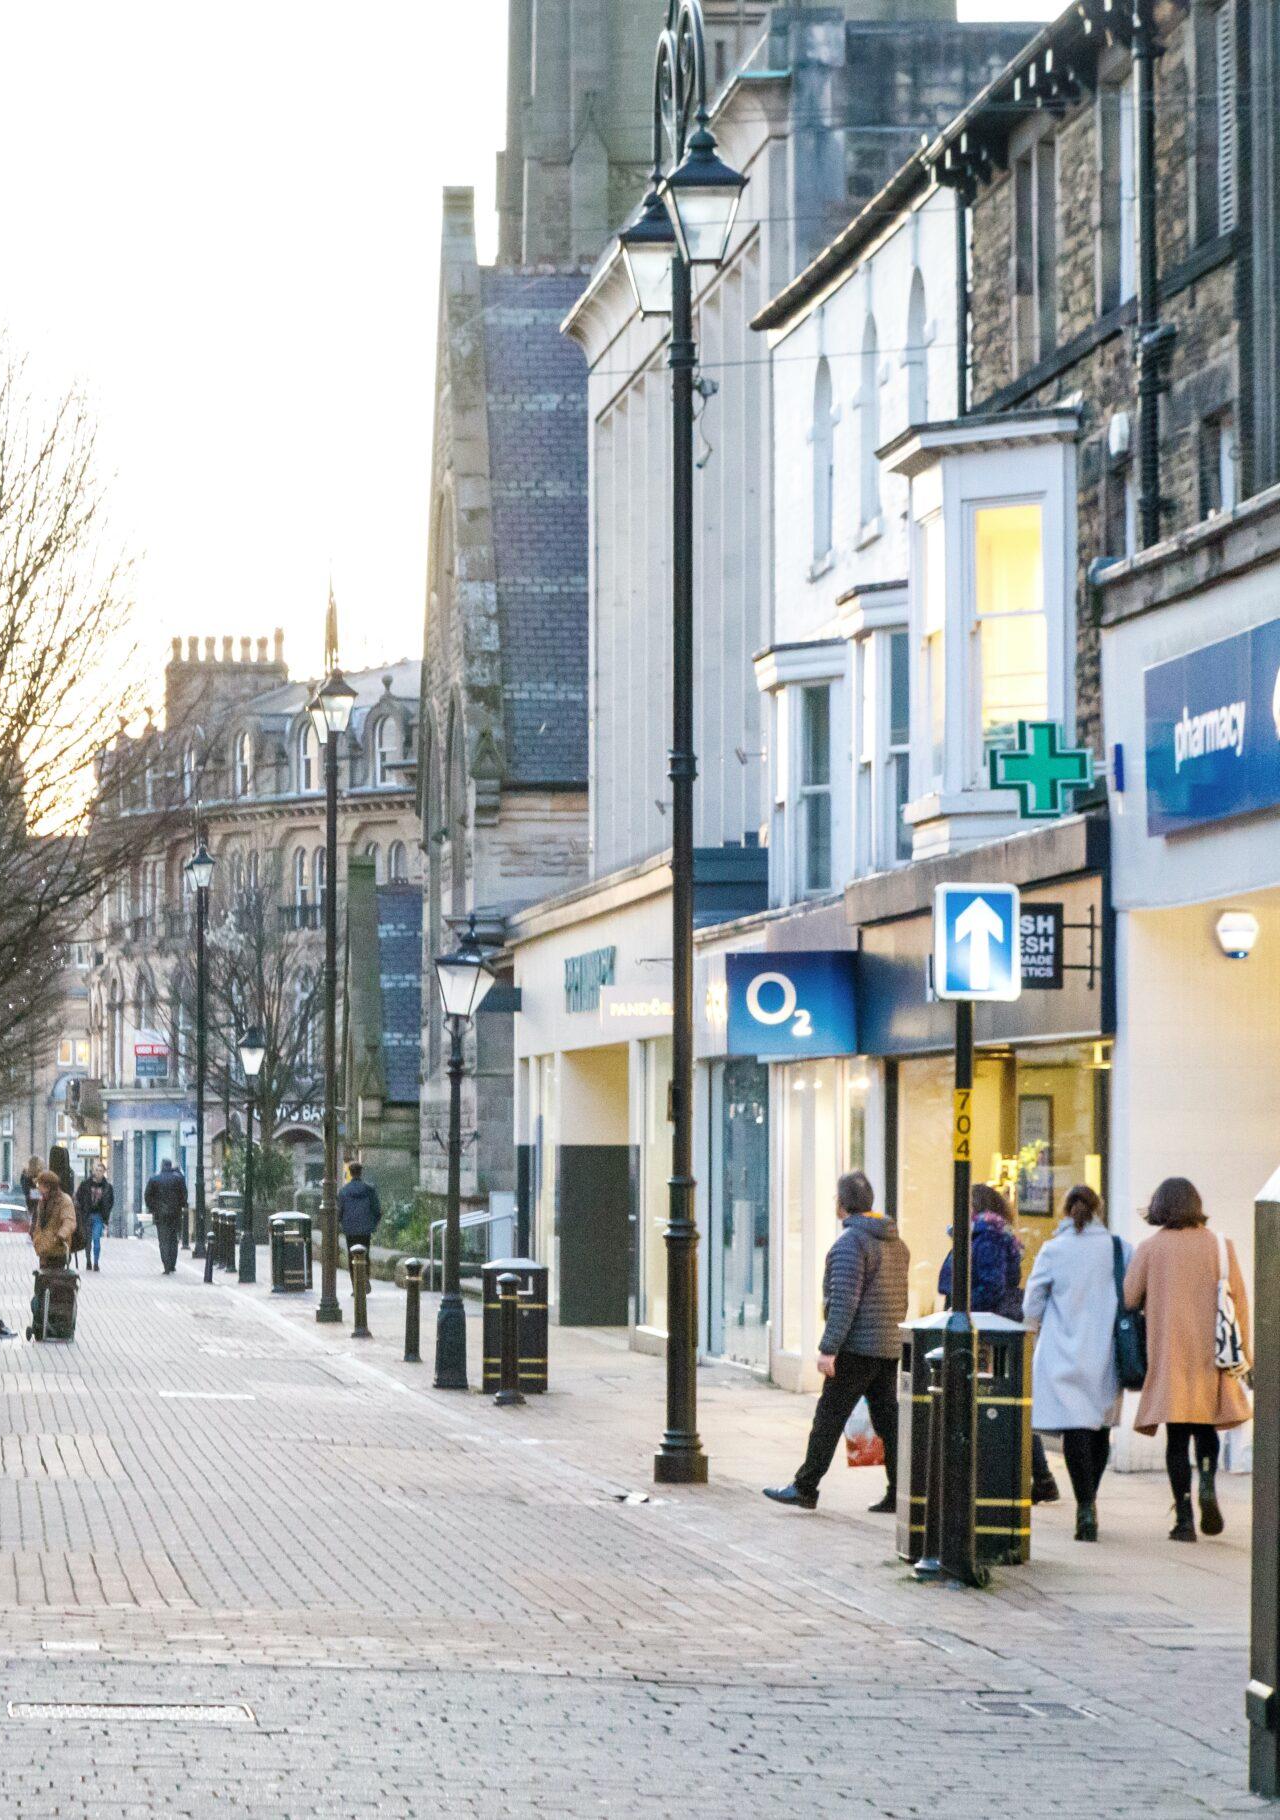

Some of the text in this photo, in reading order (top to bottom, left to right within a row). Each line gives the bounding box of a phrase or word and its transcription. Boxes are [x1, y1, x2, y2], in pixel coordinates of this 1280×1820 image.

[1174, 700, 1246, 774] pharmacy
[1020, 915, 1054, 935] SH
[1020, 935, 1054, 954] SH
[1020, 954, 1055, 966] MADE
[1020, 966, 1055, 978] ETICS
[609, 997, 674, 1017] PANDOR
[956, 1091, 971, 1157] 704
